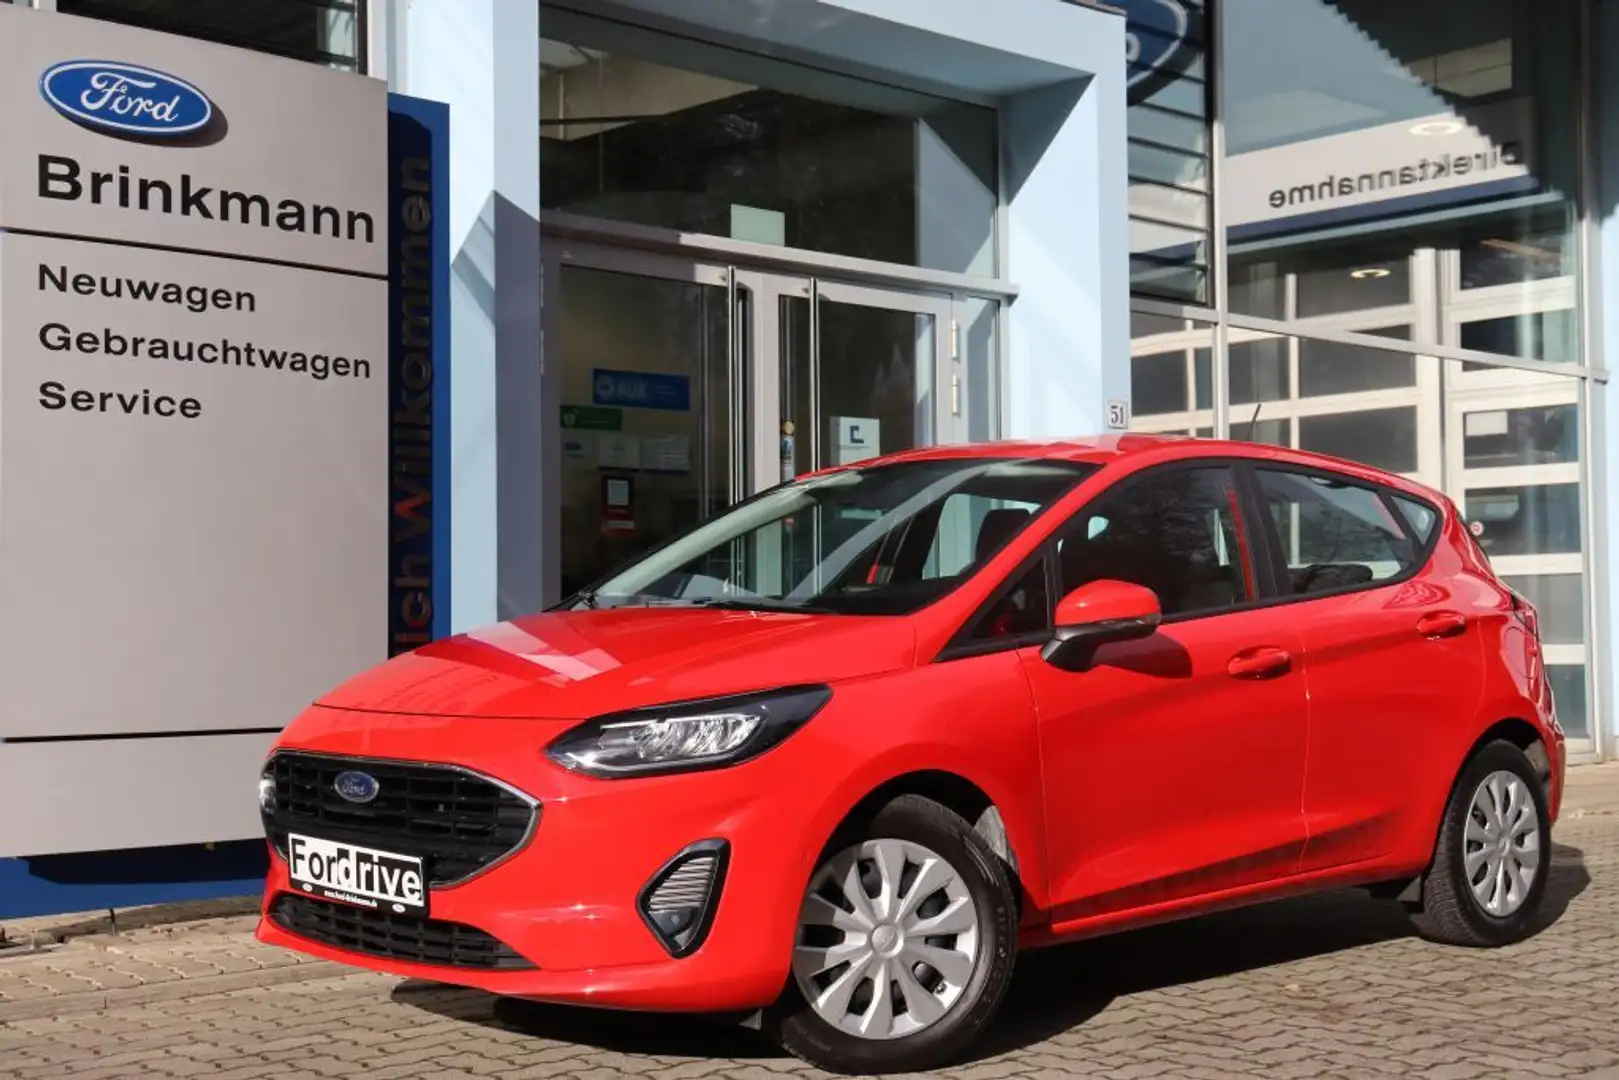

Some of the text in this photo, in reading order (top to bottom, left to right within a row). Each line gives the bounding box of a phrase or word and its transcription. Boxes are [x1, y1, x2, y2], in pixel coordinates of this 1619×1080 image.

[81, 72, 180, 123] Ford
[38, 153, 374, 244] Brinkmann
[39, 263, 256, 313] Neuwagen
[38, 322, 371, 381] Gebrauchtwagen
[394, 157, 431, 542] Willkommen
[38, 381, 202, 419] Service
[1110, 404, 1124, 424] 51
